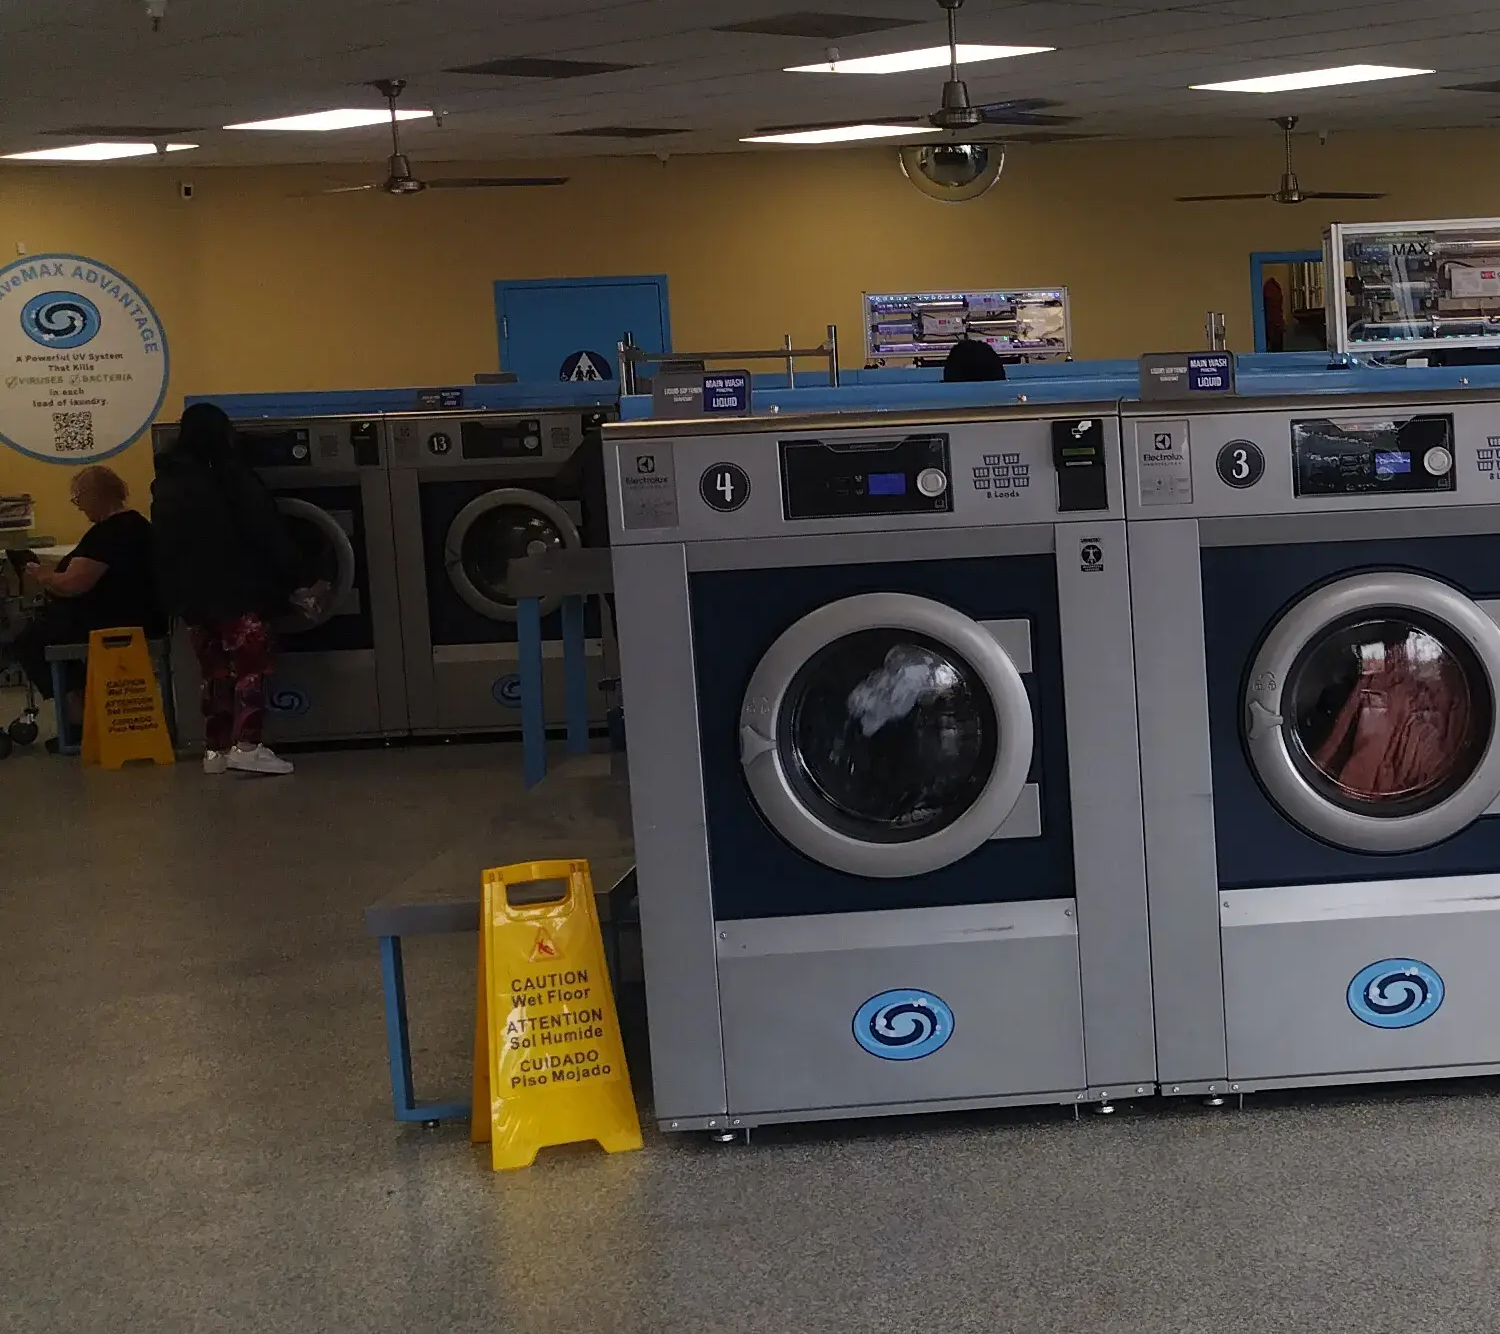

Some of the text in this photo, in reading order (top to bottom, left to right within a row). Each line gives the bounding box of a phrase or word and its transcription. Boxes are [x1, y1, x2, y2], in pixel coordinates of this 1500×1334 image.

[0, 263, 159, 355] veMAX ADVANTAGE
[16, 352, 124, 363] A Powerful UV System
[1190, 358, 1228, 368] MAIN WASH
[72, 363, 94, 371] Kills
[19, 373, 134, 385] VIRUSES BACTERIA
[705, 378, 744, 388] MAIN WASH
[1197, 376, 1222, 387] LIQUID
[712, 397, 737, 408] LIQUID
[433, 436, 447, 451] 13
[1143, 453, 1184, 462] Electrolux
[1232, 449, 1250, 479] 3
[625, 476, 668, 485] Electrolux
[1489, 472, 1494, 480] 8
[716, 472, 734, 502] 4
[994, 490, 1020, 498] Loads
[511, 969, 589, 993] CAUTION
[511, 987, 591, 1009] Wet Floor
[507, 1008, 603, 1035] ATTENTION
[510, 1025, 603, 1051] Sol Humide
[520, 1049, 599, 1073] CUIDADO
[511, 1065, 611, 1089] Piso Mojado
